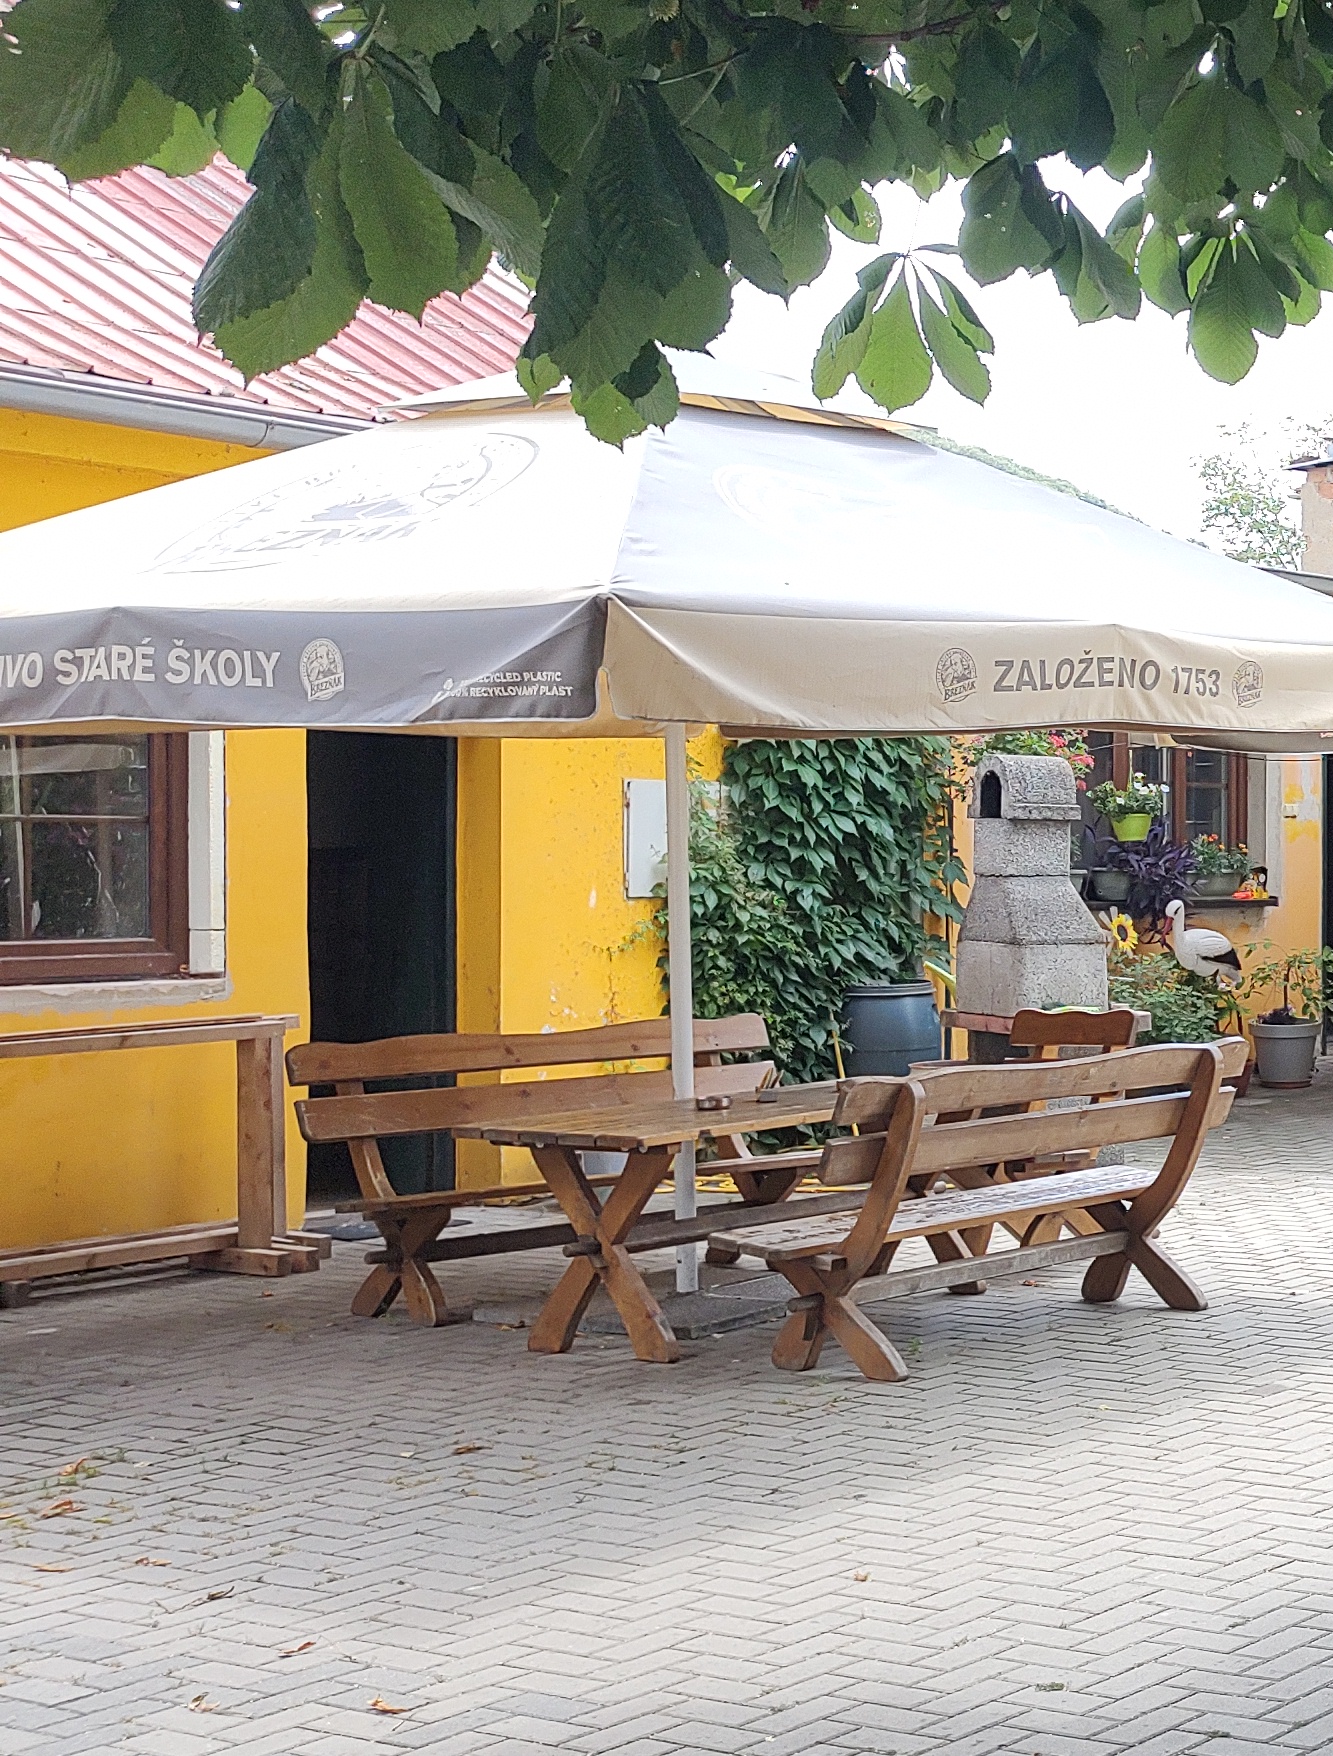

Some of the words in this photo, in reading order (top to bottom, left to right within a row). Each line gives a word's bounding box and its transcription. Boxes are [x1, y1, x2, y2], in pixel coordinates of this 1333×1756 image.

[53, 637, 156, 685] STARÉ
[164, 639, 281, 688] ŠKOLY
[523, 671, 562, 682] PLASTIC
[993, 649, 1161, 693] ZALOŽENO
[1171, 665, 1221, 698] 1753
